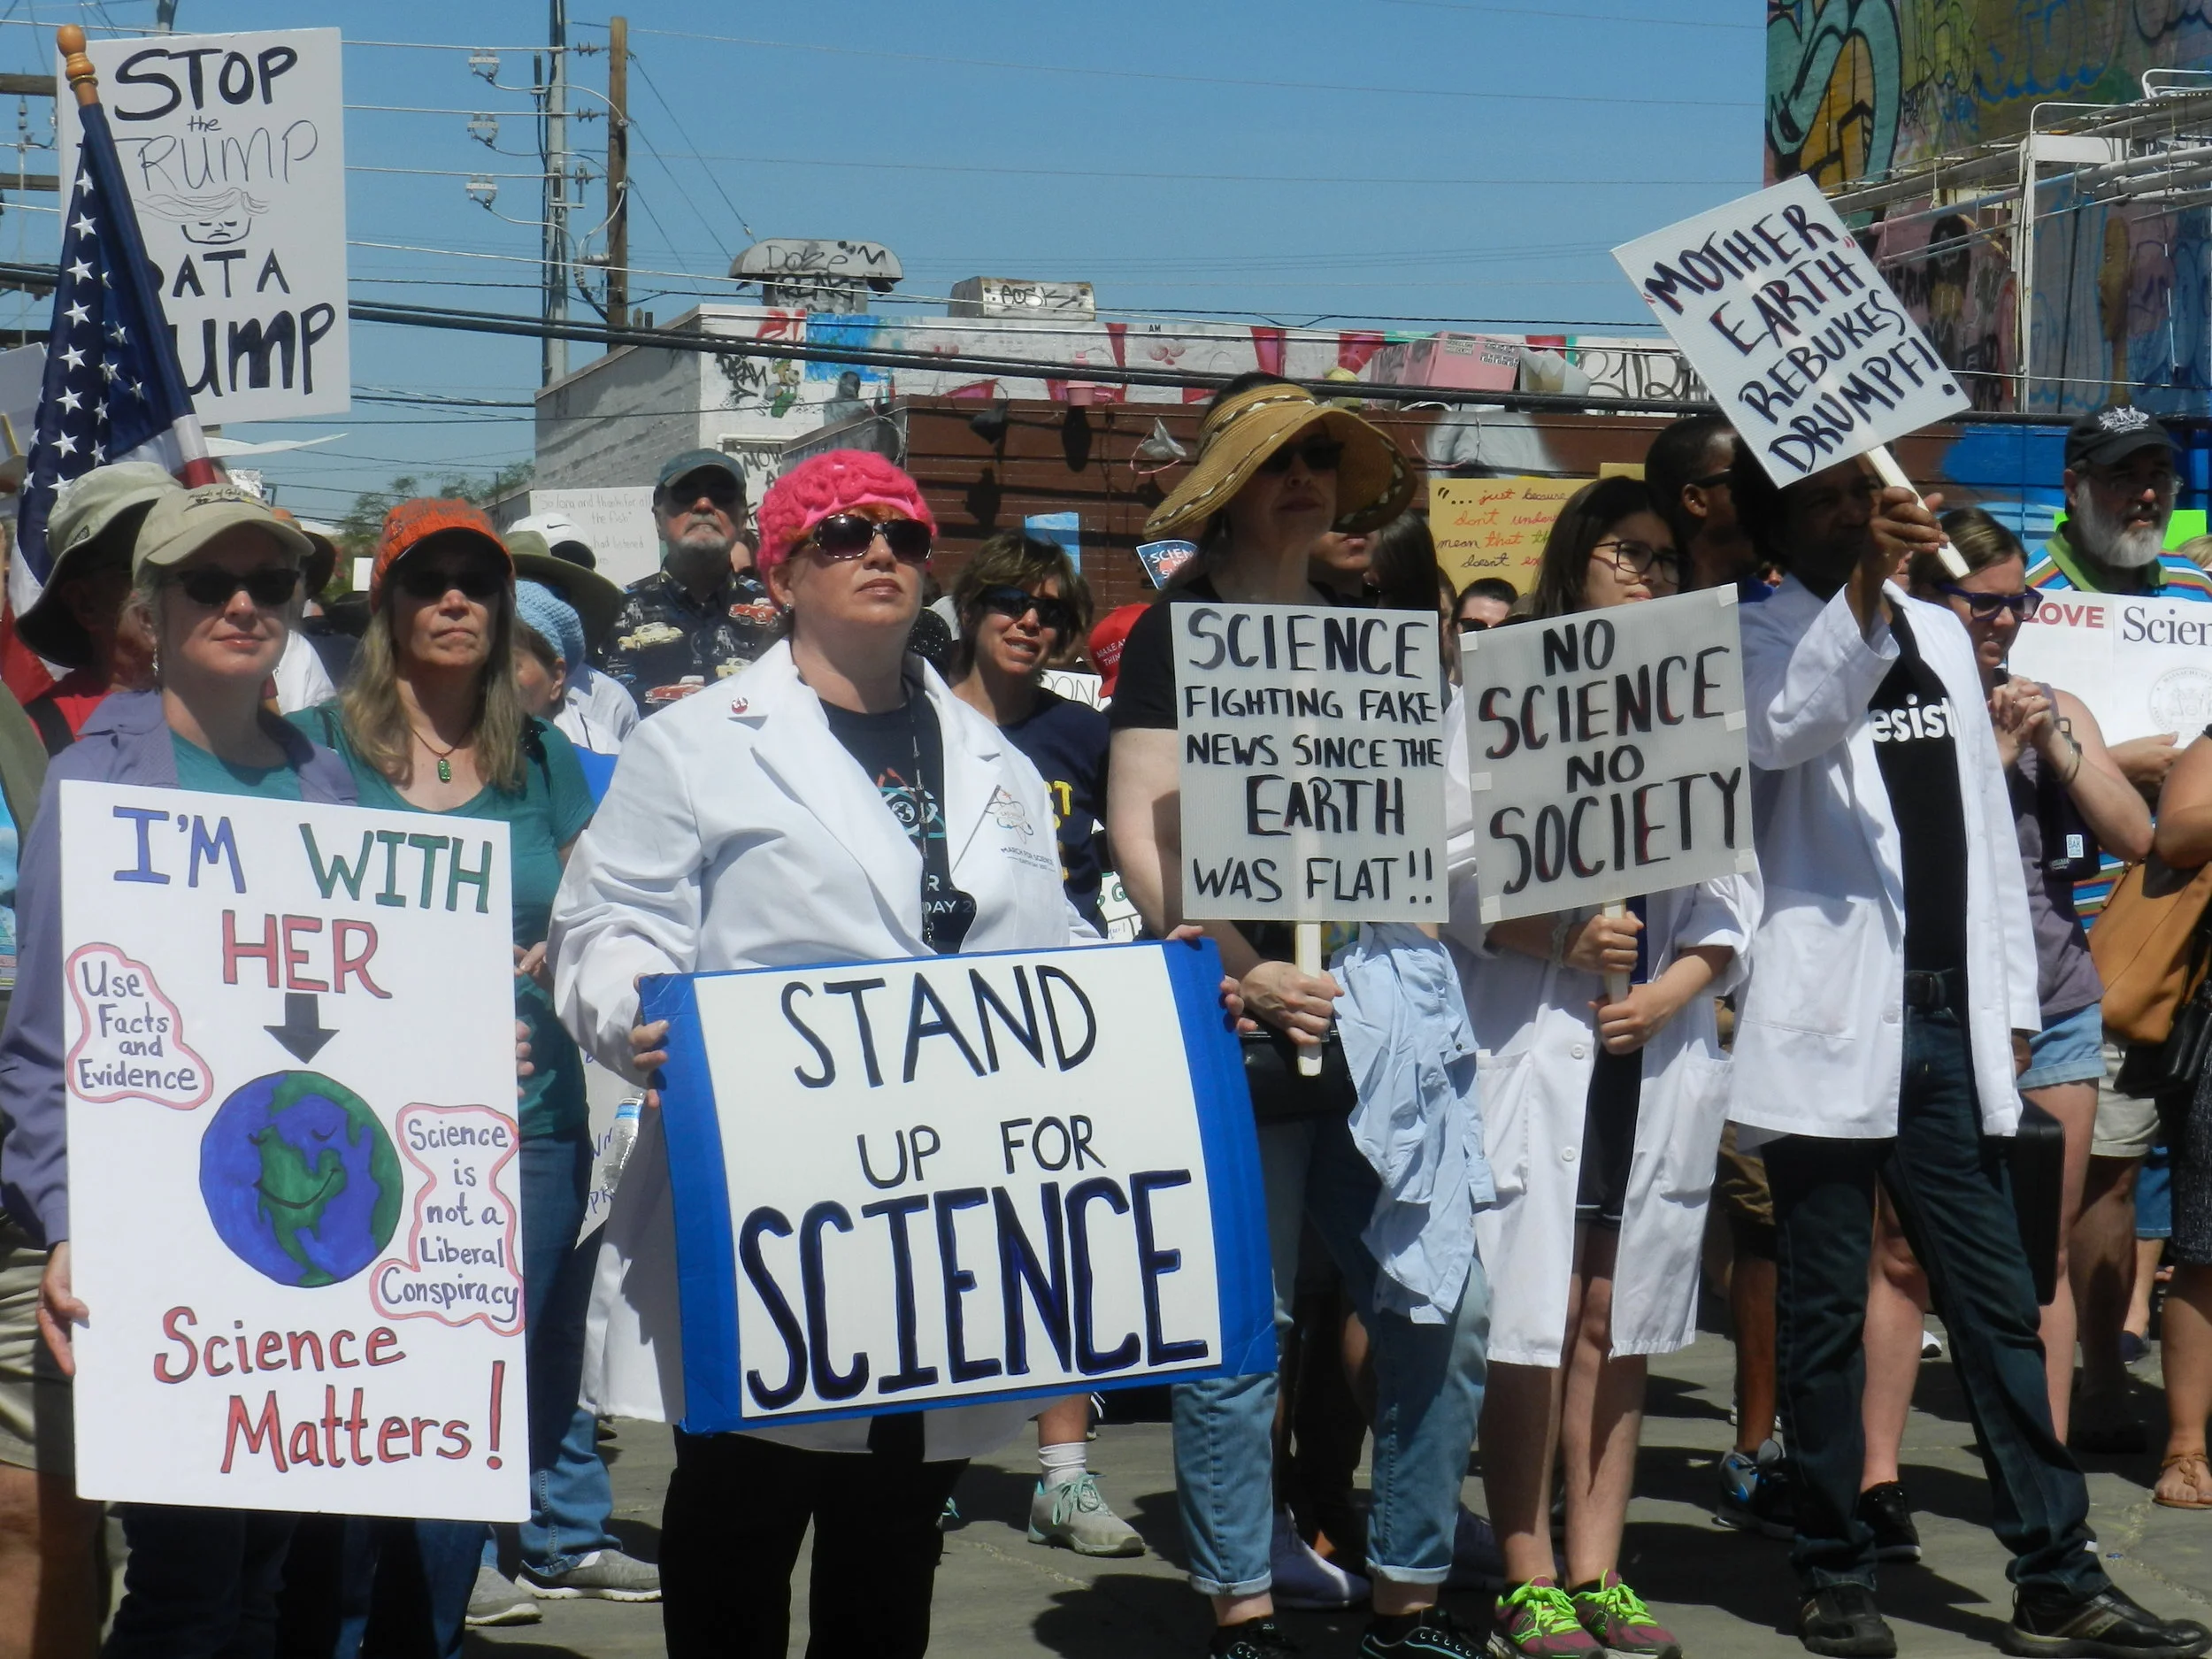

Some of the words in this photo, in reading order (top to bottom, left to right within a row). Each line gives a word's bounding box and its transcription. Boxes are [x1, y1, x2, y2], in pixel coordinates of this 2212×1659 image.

[114, 46, 298, 121] STOP
[187, 115, 222, 132] the
[167, 303, 335, 397] UMP
[1738, 289, 1907, 425] REBUKES
[1768, 337, 1957, 474] DRUMPF!
[578, 494, 594, 509] and
[592, 511, 607, 525] the
[1479, 488, 1516, 505] just
[1150, 549, 1194, 564] SCIEN
[1437, 539, 1480, 549] mean
[1485, 530, 1525, 549] that
[1531, 530, 1550, 545] th
[1521, 556, 1543, 566] ex
[1103, 652, 1122, 666] THIN
[1187, 607, 1430, 680] SCIENCE
[1542, 618, 1616, 677] NO
[1184, 685, 1344, 719] FIGHTING
[1359, 689, 1438, 726] FAKE
[1479, 645, 1731, 760] SCIENCE
[1868, 693, 1955, 743] esist
[1187, 733, 1279, 766] NEWS
[1293, 733, 1388, 769] SINCE
[1392, 738, 1444, 768] THE
[1566, 744, 1645, 794] NO
[1245, 773, 1405, 836] EARTH
[1489, 766, 1742, 895] SOCIETY
[111, 805, 247, 895] I'M
[298, 823, 493, 914] WITH
[1194, 856, 1283, 902] WAS
[1306, 848, 1433, 904] FLAT!!
[81, 961, 145, 998] Use
[222, 910, 394, 999] HER
[98, 1002, 170, 1039] Facts
[781, 964, 1097, 1088] STAND
[119, 1034, 164, 1058] and
[78, 1058, 197, 1091] Evidence
[408, 1118, 509, 1151] Science
[856, 1124, 941, 1189] UP
[1000, 1114, 1107, 1175] FOR
[453, 1157, 477, 1188] is
[426, 1192, 474, 1226] not
[481, 1204, 505, 1226] a
[420, 1236, 505, 1268] Liberal
[380, 1265, 519, 1323] Conspiracy
[739, 1168, 1209, 1410] SCIENCE
[154, 1306, 407, 1385] Science
[220, 1359, 507, 1475] Matters!
